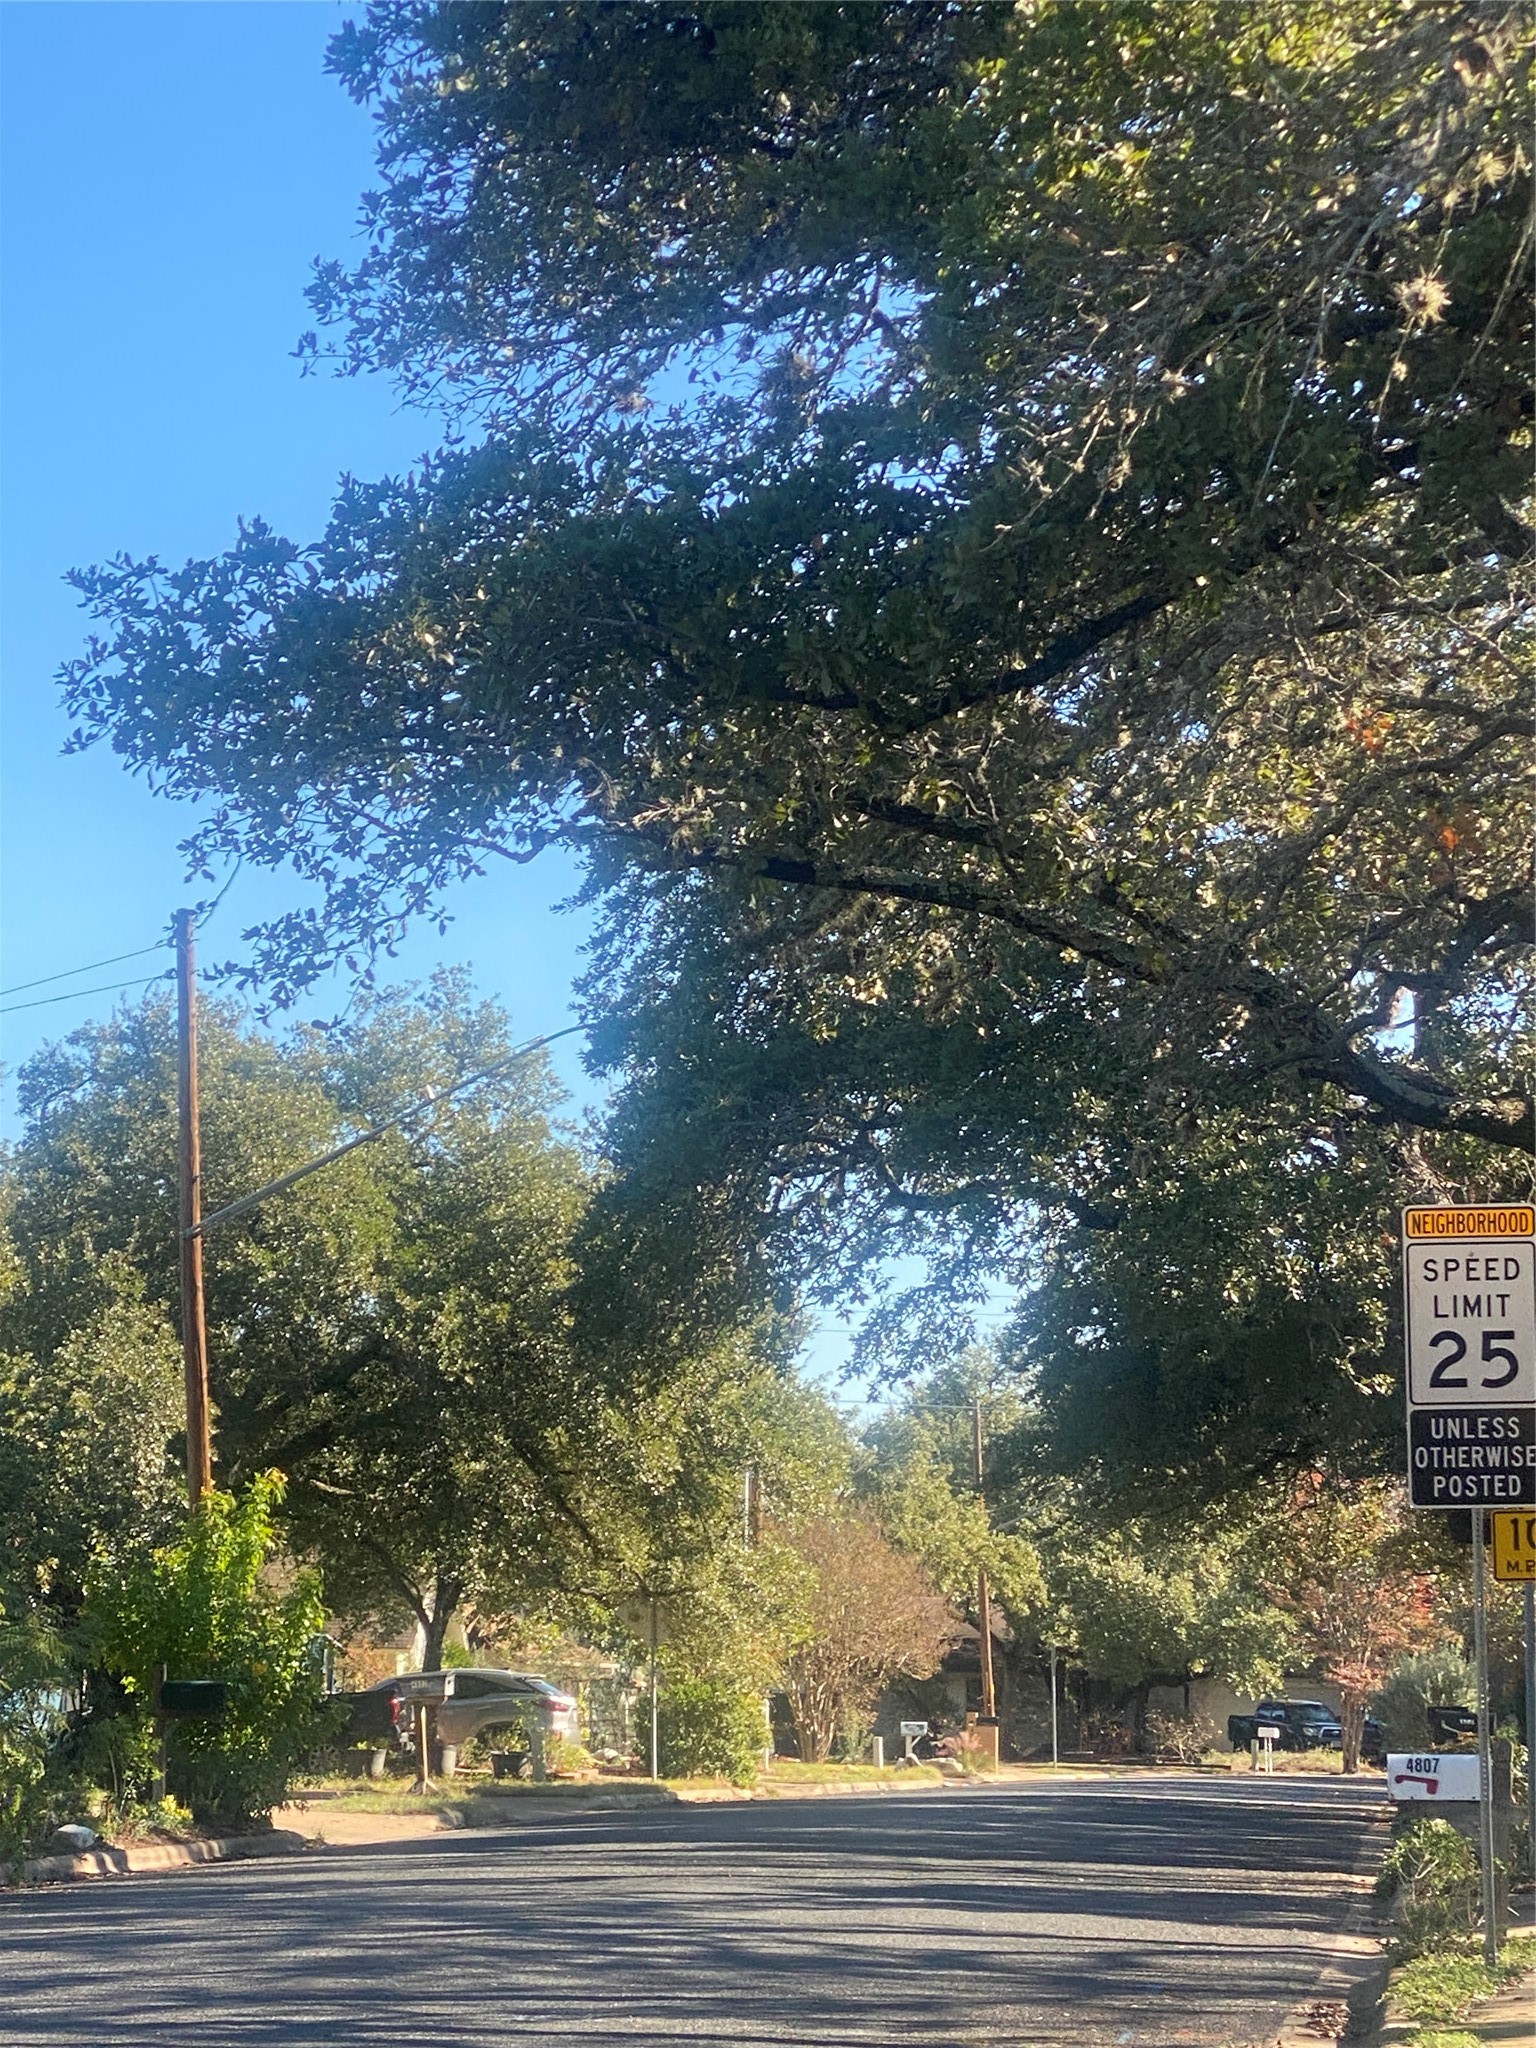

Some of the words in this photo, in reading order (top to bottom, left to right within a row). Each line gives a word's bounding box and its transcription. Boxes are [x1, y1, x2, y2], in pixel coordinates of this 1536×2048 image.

[1412, 1212, 1529, 1234] NEIGHBORHOOD
[1423, 1257, 1520, 1282] SPEED
[1433, 1294, 1511, 1318] LIMIT
[1428, 1330, 1519, 1389] 25
[1431, 1416, 1520, 1439] UNLESS
[1414, 1445, 1536, 1469] OTHERWISE
[1433, 1475, 1522, 1498] POSTED
[1406, 1757, 1440, 1773] 4807
